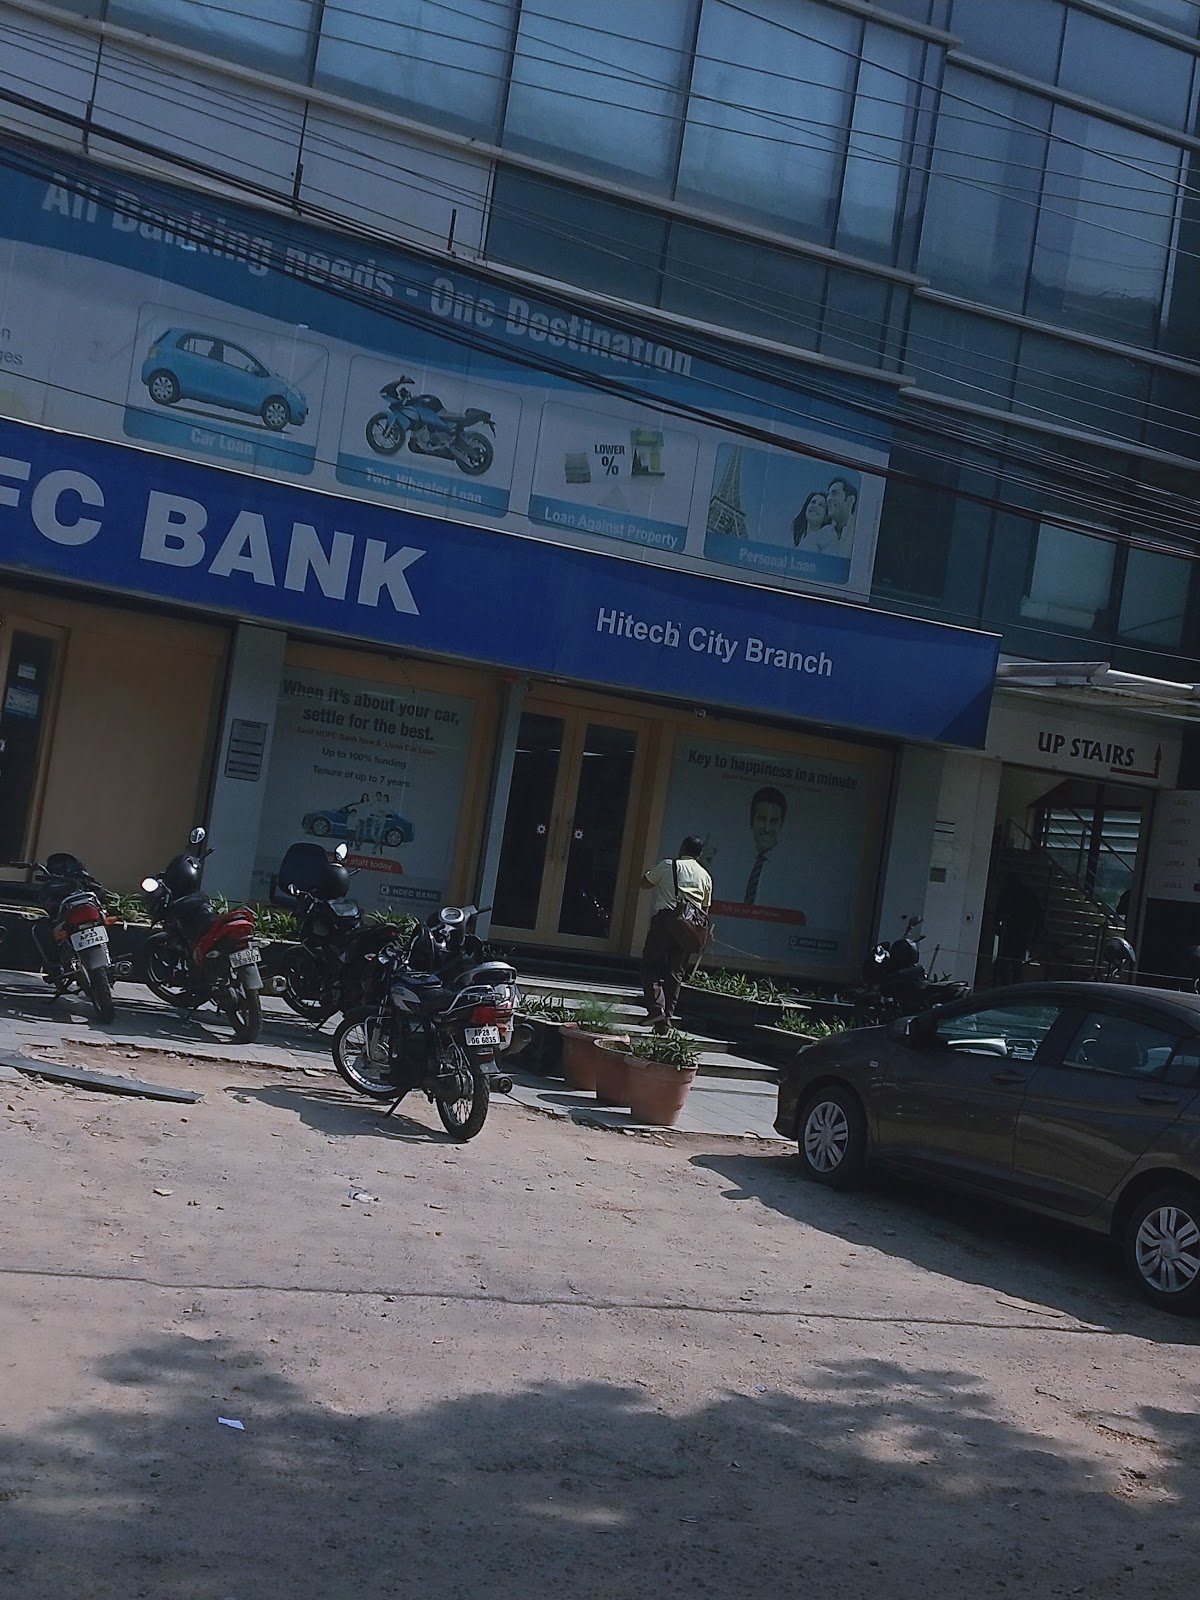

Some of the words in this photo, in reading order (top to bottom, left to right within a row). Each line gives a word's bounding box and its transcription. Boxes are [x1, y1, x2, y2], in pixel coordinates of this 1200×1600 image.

[42, 172, 99, 223] All
[112, 190, 273, 276] Banking
[284, 246, 395, 299] needs
[430, 276, 495, 328] One
[505, 298, 692, 377] Destination
[191, 428, 216, 448] Car
[219, 432, 252, 455] Loan
[594, 444, 625, 456] LOWER
[601, 455, 619, 476] %
[366, 467, 390, 485] Two
[396, 472, 449, 498] Wheeler
[452, 486, 482, 504] Loan
[544, 506, 576, 526] Loan
[578, 512, 626, 541] Against
[627, 522, 678, 549] Property
[140, 490, 427, 616] BANK
[738, 547, 788, 570] Personal
[790, 556, 817, 573] Loan
[596, 607, 683, 648] Hitech
[688, 626, 738, 664] City
[745, 637, 834, 677] Branch
[282, 678, 324, 700] When
[328, 682, 351, 705] it's
[353, 692, 396, 713] about
[398, 701, 432, 720] your
[434, 708, 460, 727] car,
[302, 707, 345, 727] settle
[348, 713, 371, 731] for
[373, 716, 397, 735] the
[399, 720, 435, 742] best.
[322, 746, 336, 758] Up
[337, 750, 347, 759] to
[349, 751, 372, 763] 100%
[374, 755, 407, 770] funding
[1037, 731, 1066, 754] UP
[1070, 737, 1136, 767] STAIRS
[312, 764, 343, 777] Tenure
[344, 769, 354, 779] of
[355, 772, 366, 783] up
[369, 773, 377, 783] to
[387, 777, 411, 789] years
[687, 748, 711, 769] Key
[715, 753, 728, 769] to
[730, 757, 793, 779] happiness
[796, 767, 808, 782] in
[808, 771, 817, 783] a
[817, 772, 859, 791] minute
[350, 857, 369, 867] staff
[370, 859, 393, 871] today
[392, 887, 415, 898] HDFC
